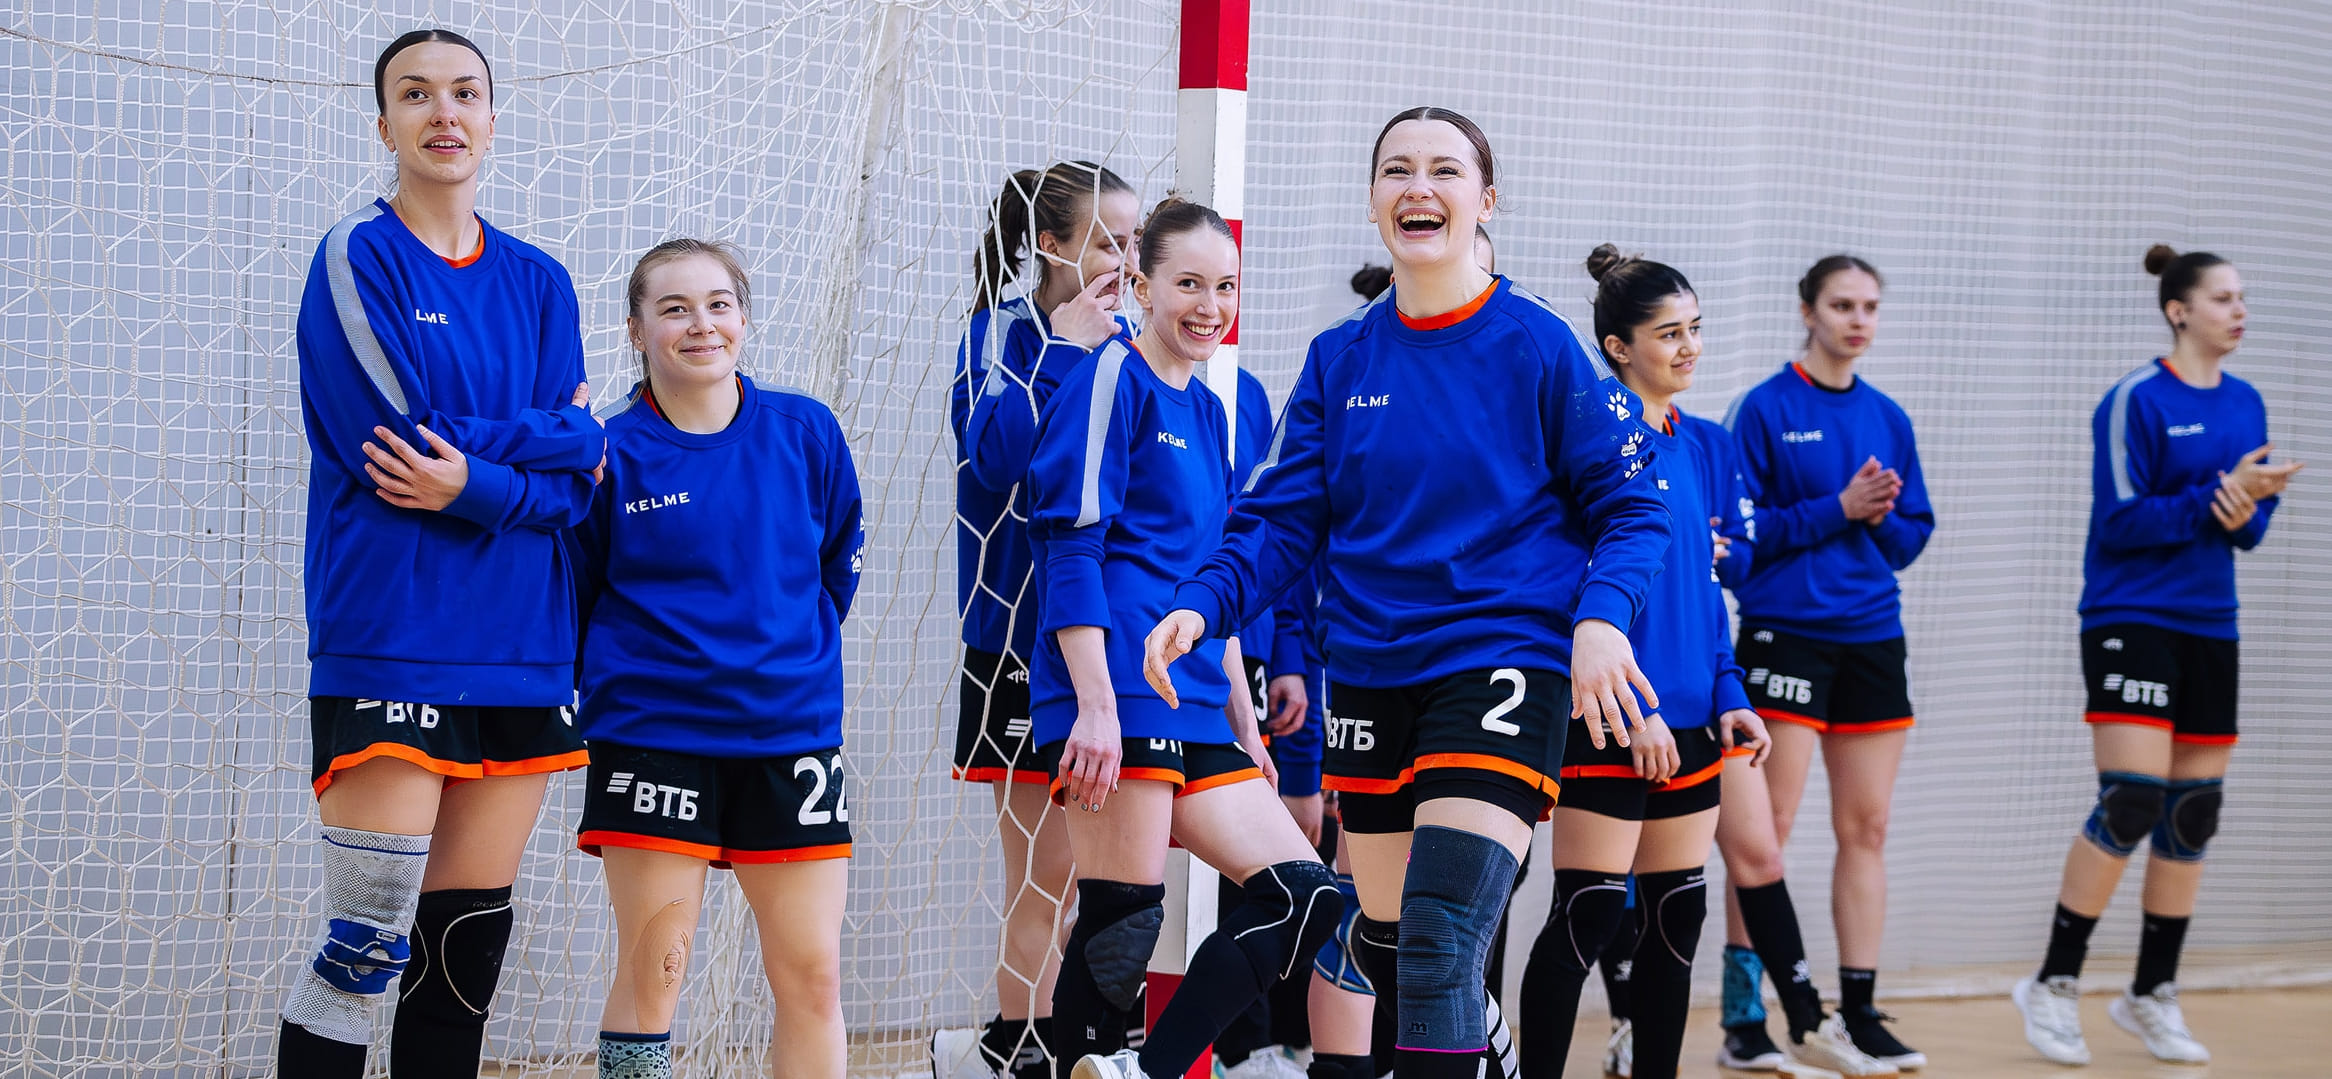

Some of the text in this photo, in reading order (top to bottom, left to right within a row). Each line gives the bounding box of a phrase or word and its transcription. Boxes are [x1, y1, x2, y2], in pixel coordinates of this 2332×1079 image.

[415, 308, 449, 325] LME
[625, 491, 691, 515] KELME
[1481, 667, 1527, 737] 2
[1766, 673, 1813, 705] ВТБ
[2121, 679, 2169, 708] ВТБ
[633, 780, 700, 822] ВТБ
